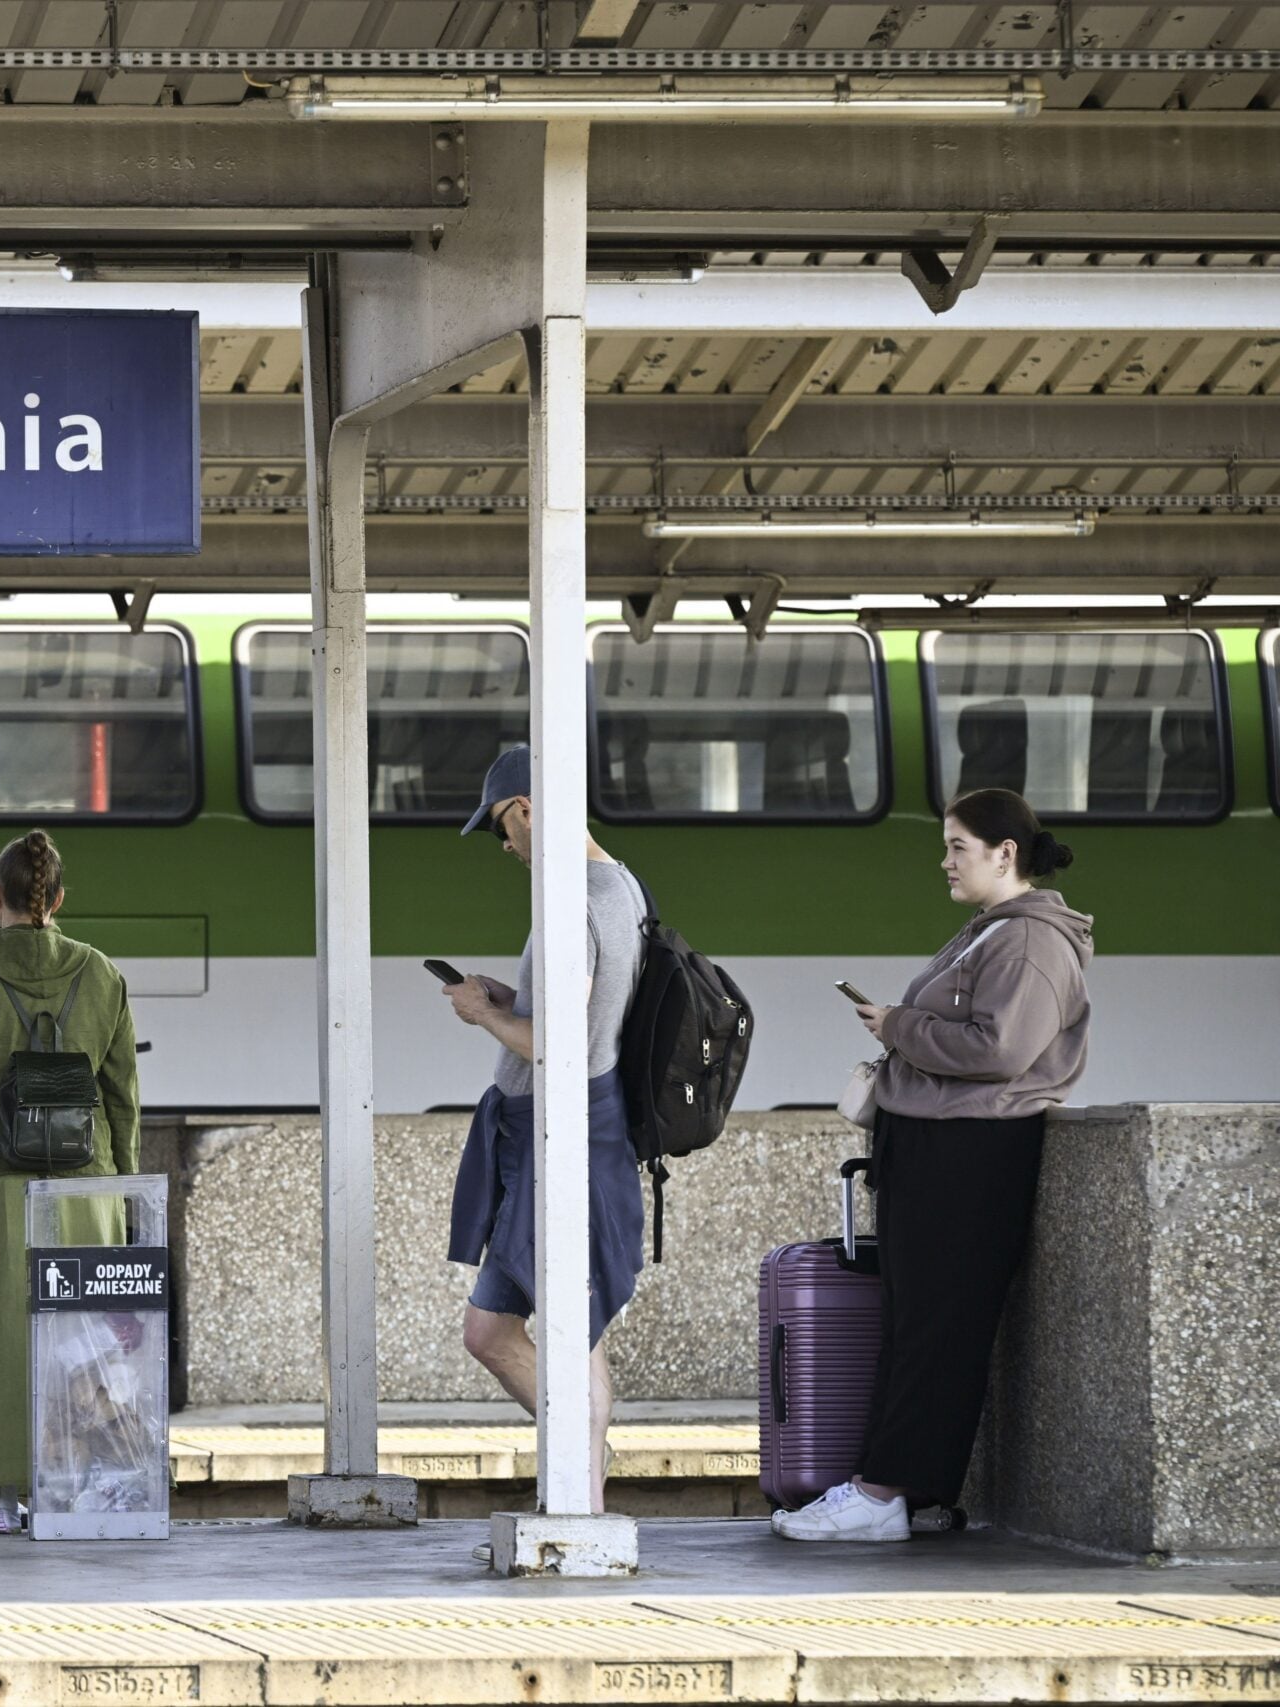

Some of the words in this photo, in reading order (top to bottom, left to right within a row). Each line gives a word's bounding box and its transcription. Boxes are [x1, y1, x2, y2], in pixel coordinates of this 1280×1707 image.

[96, 1264, 152, 1279] ODPADY
[85, 1280, 163, 1295] ZMIESZANE
[68, 1674, 89, 1694] 30
[601, 1670, 623, 1690] 30
